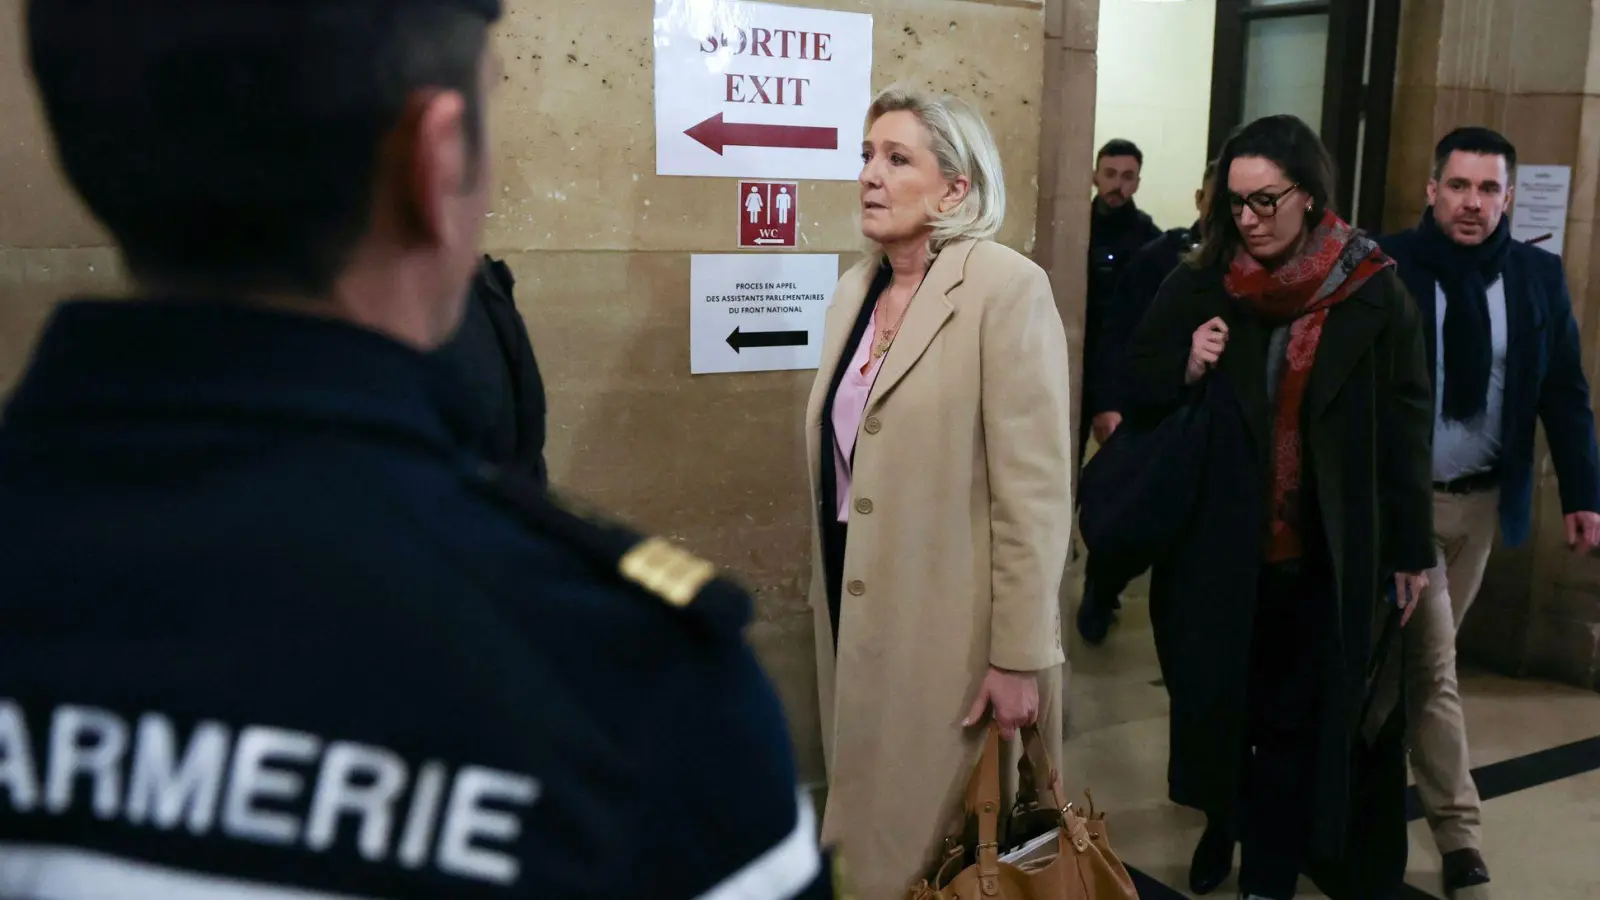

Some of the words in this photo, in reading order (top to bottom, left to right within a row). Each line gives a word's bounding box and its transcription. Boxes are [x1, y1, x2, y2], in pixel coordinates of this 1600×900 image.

[723, 73, 810, 106] EXIT
[759, 228, 779, 238] WC
[735, 282, 763, 290] PROCES
[765, 282, 774, 290] EN
[776, 282, 797, 290] APPEL
[706, 295, 720, 303] DES
[721, 294, 764, 302] ASSISTANTS
[765, 293, 825, 301] PARLEMENTAIRES
[741, 306, 765, 314] FRONT
